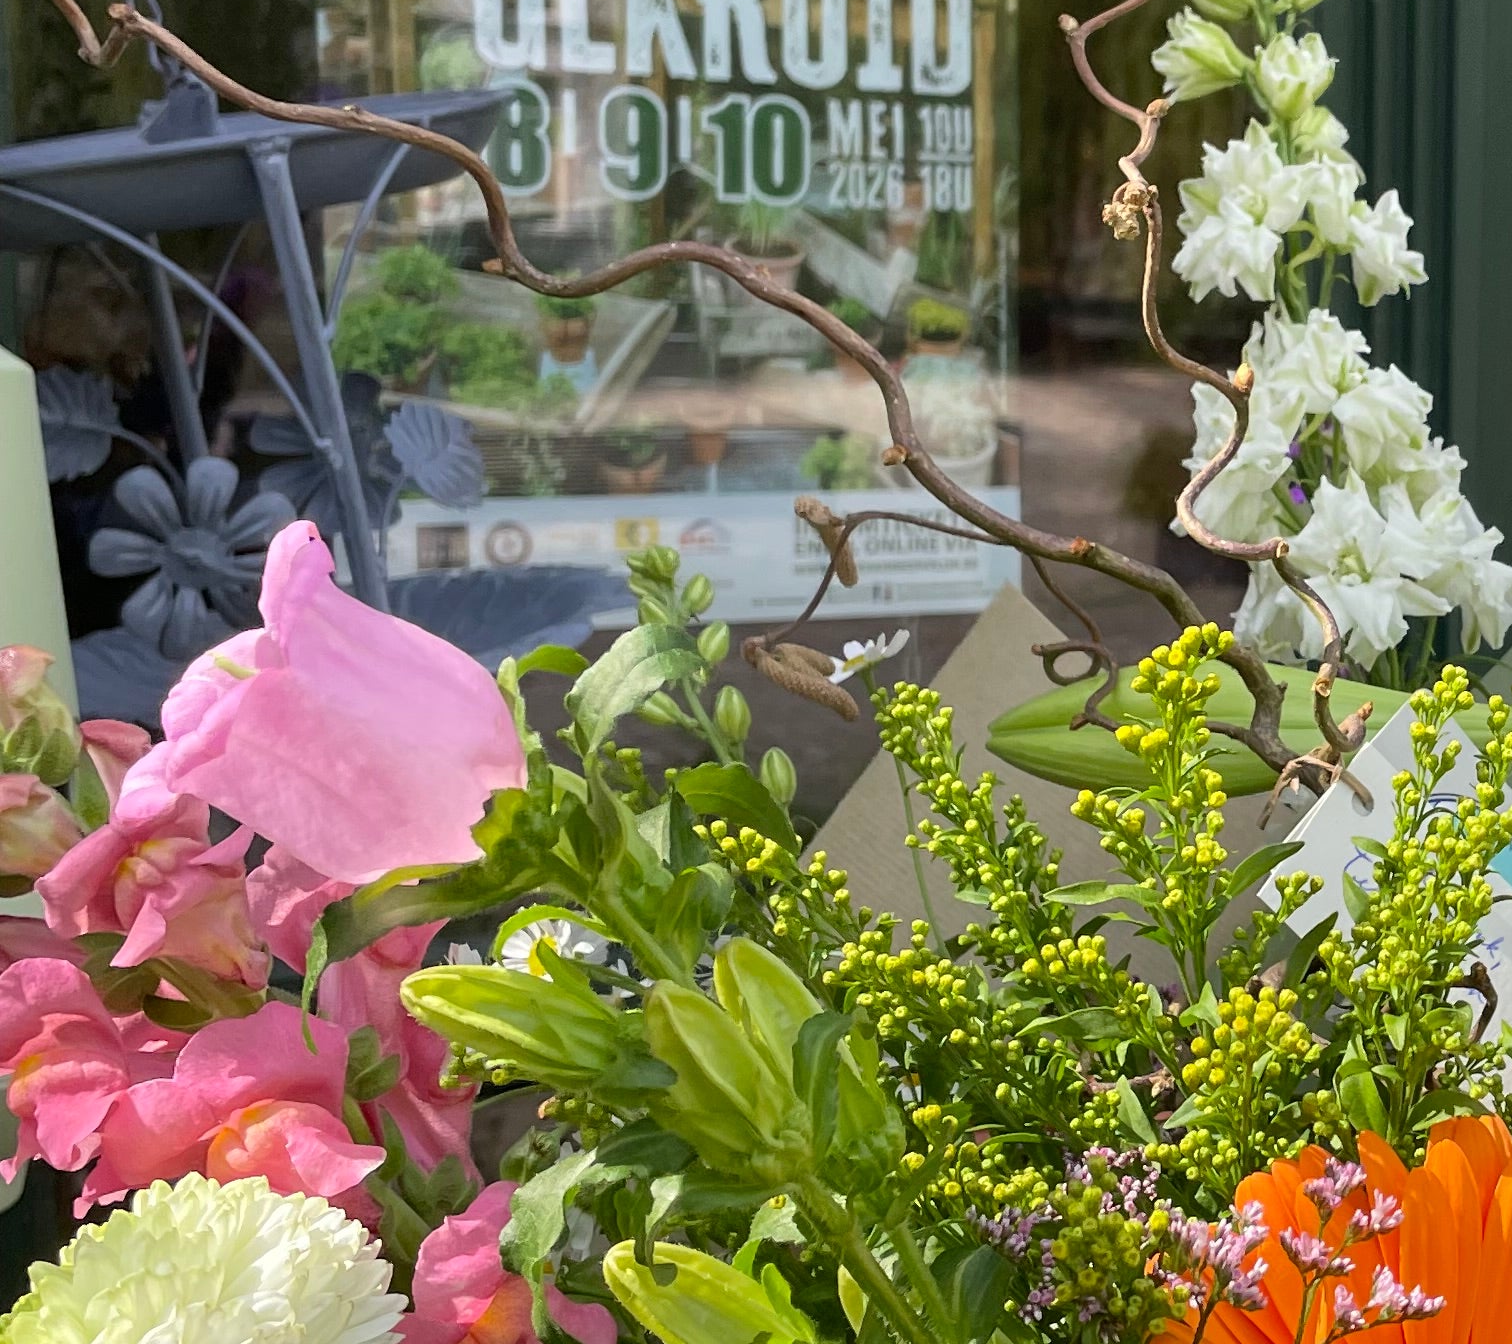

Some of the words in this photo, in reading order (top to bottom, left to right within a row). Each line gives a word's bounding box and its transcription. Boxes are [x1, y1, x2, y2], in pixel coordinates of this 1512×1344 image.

[487, 76, 552, 198] 8
[600, 82, 669, 202] 9
[703, 92, 812, 207] 10
[827, 96, 905, 159] MEI
[919, 103, 974, 153] 10U
[828, 162, 906, 208] 2026
[919, 164, 974, 213] 18U
